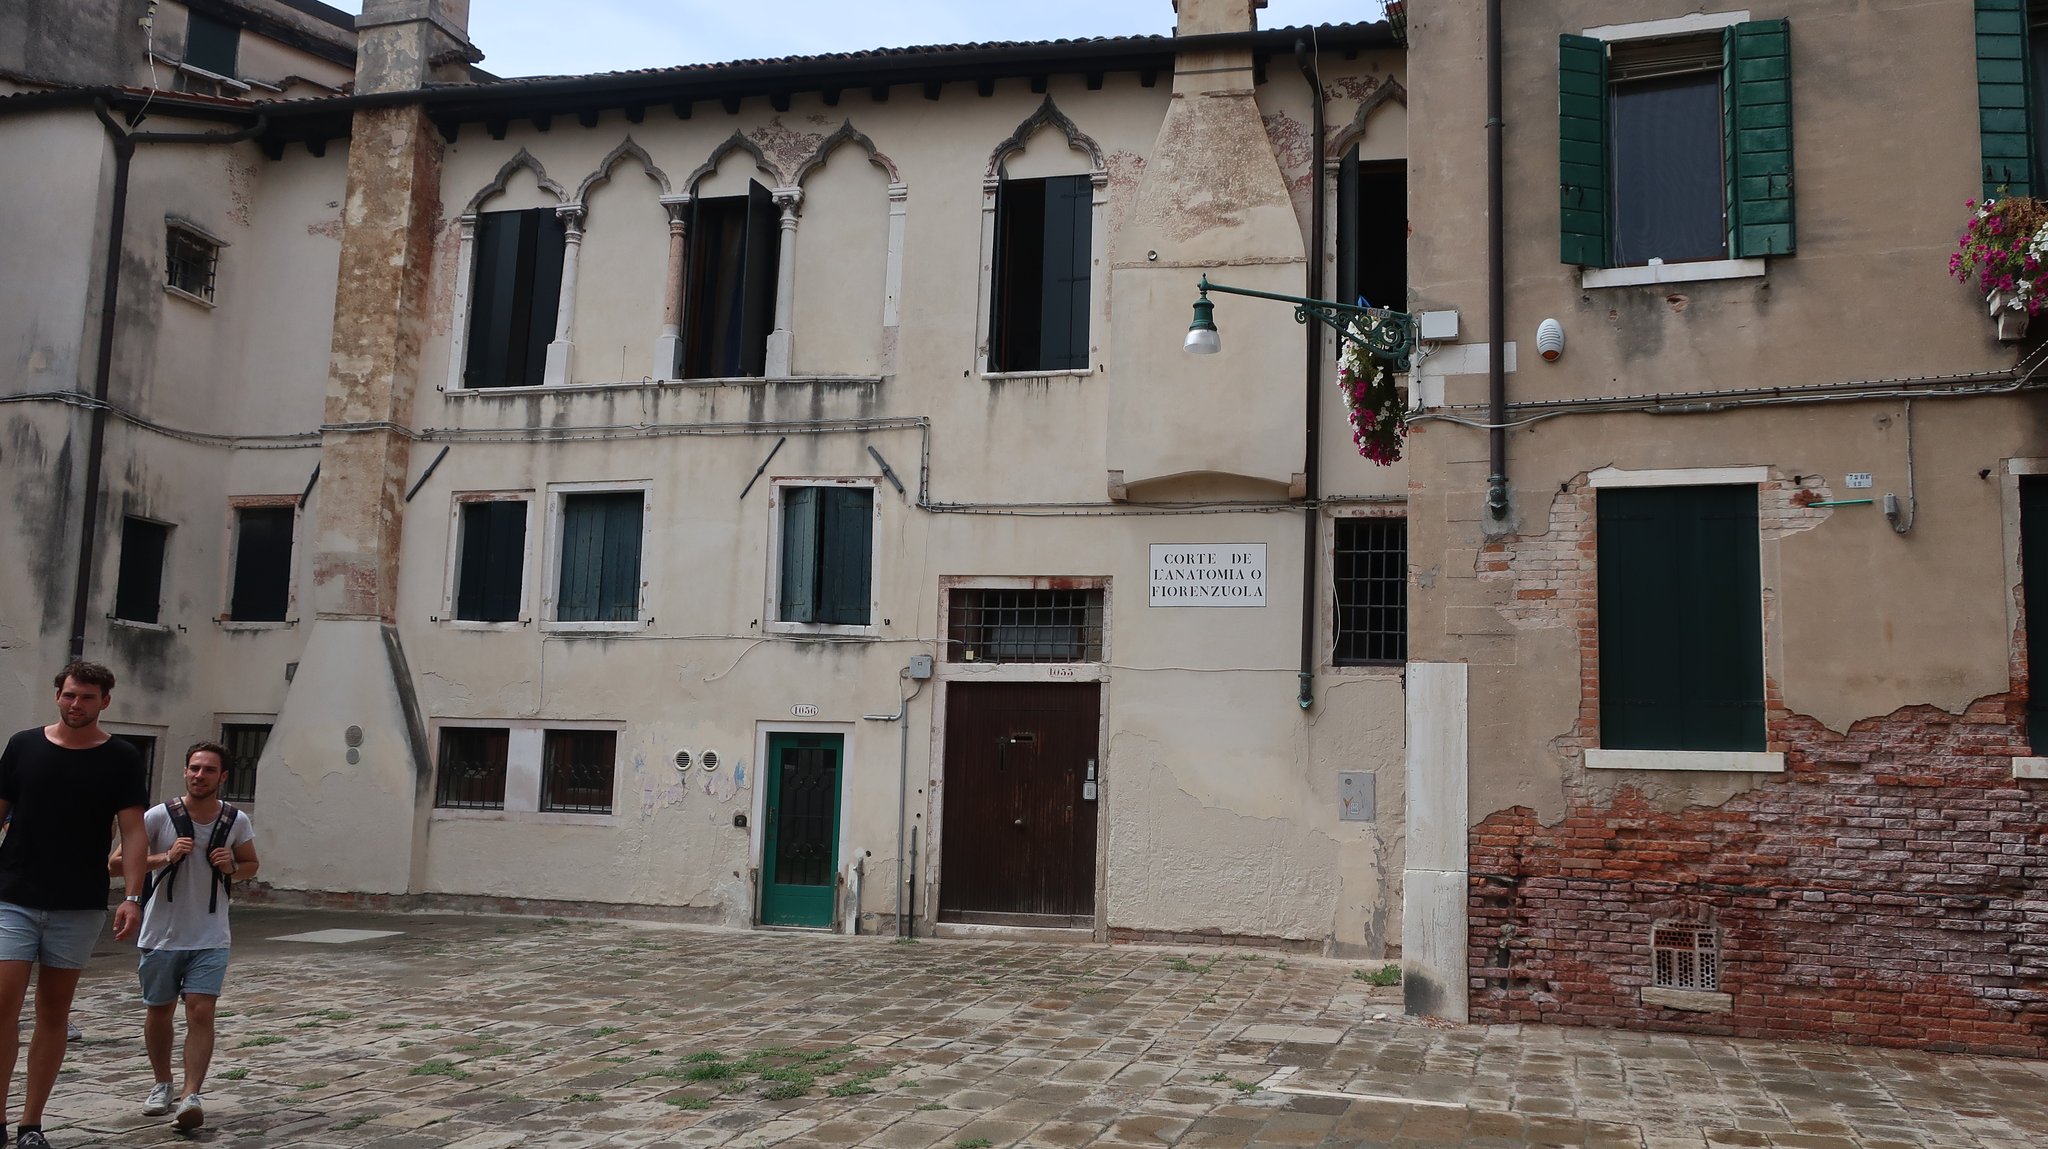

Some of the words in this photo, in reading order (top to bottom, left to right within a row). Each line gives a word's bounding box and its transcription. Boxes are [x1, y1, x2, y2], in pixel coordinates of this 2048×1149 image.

[1164, 553, 1217, 565] CORTE
[1232, 553, 1252, 565] DE
[1154, 569, 1244, 580] L'ANATOMIA
[1251, 569, 1262, 580] O
[1152, 586, 1263, 597] FIORENZUOLA
[794, 706, 817, 714] 1056
